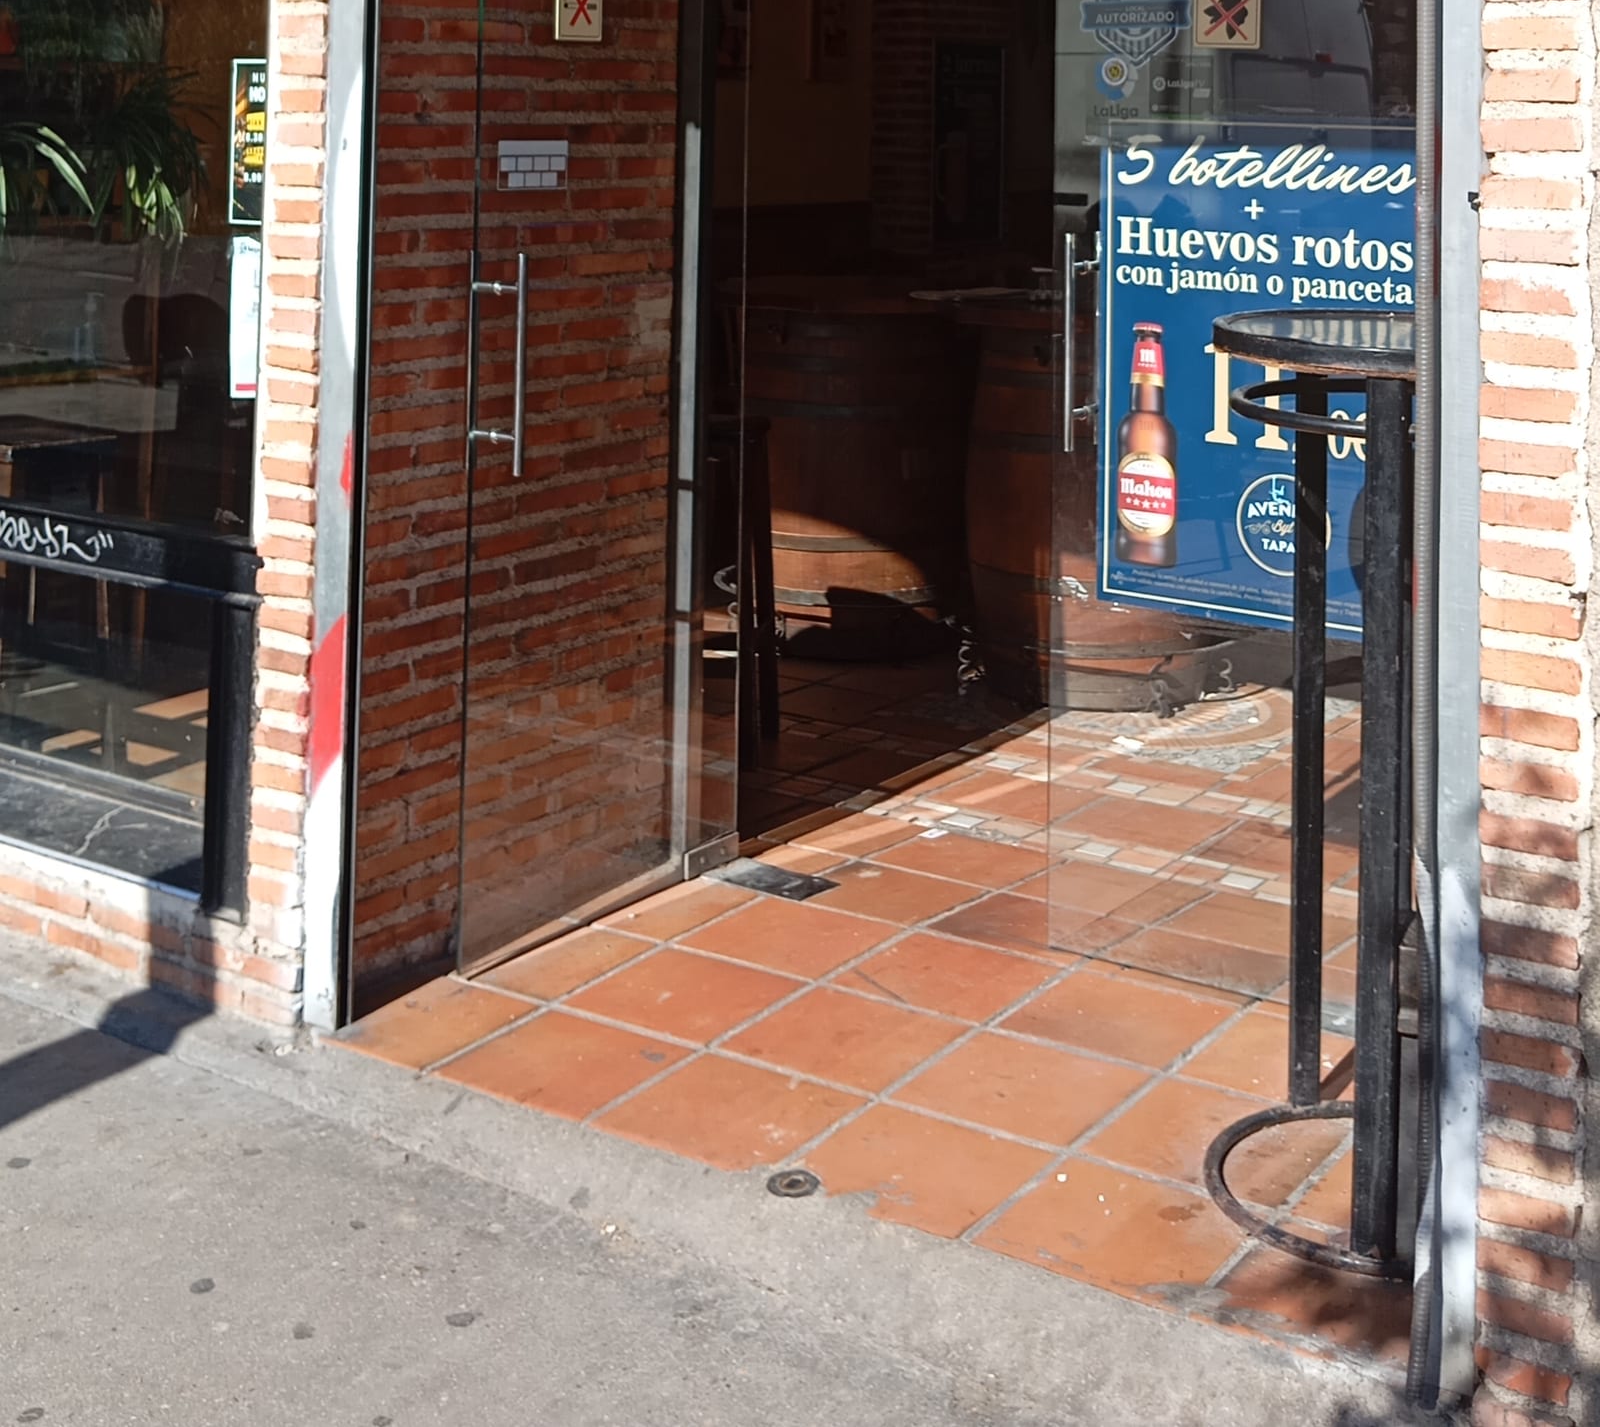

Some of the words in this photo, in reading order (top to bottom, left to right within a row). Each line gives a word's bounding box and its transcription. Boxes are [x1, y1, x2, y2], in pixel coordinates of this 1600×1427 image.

[1095, 11, 1175, 24] AUTORIZADO
[1093, 104, 1139, 120] LaLiga
[1117, 139, 1156, 186] 5
[1168, 135, 1416, 194] botellines
[1116, 215, 1279, 264] Huevos
[1292, 228, 1414, 273] rotos
[1116, 264, 1164, 287] con
[1166, 261, 1259, 295] jamón
[1266, 275, 1284, 295] o
[1291, 276, 1415, 305] panceta
[1120, 477, 1173, 501] Mahou
[1261, 538, 1296, 554] TAPA
